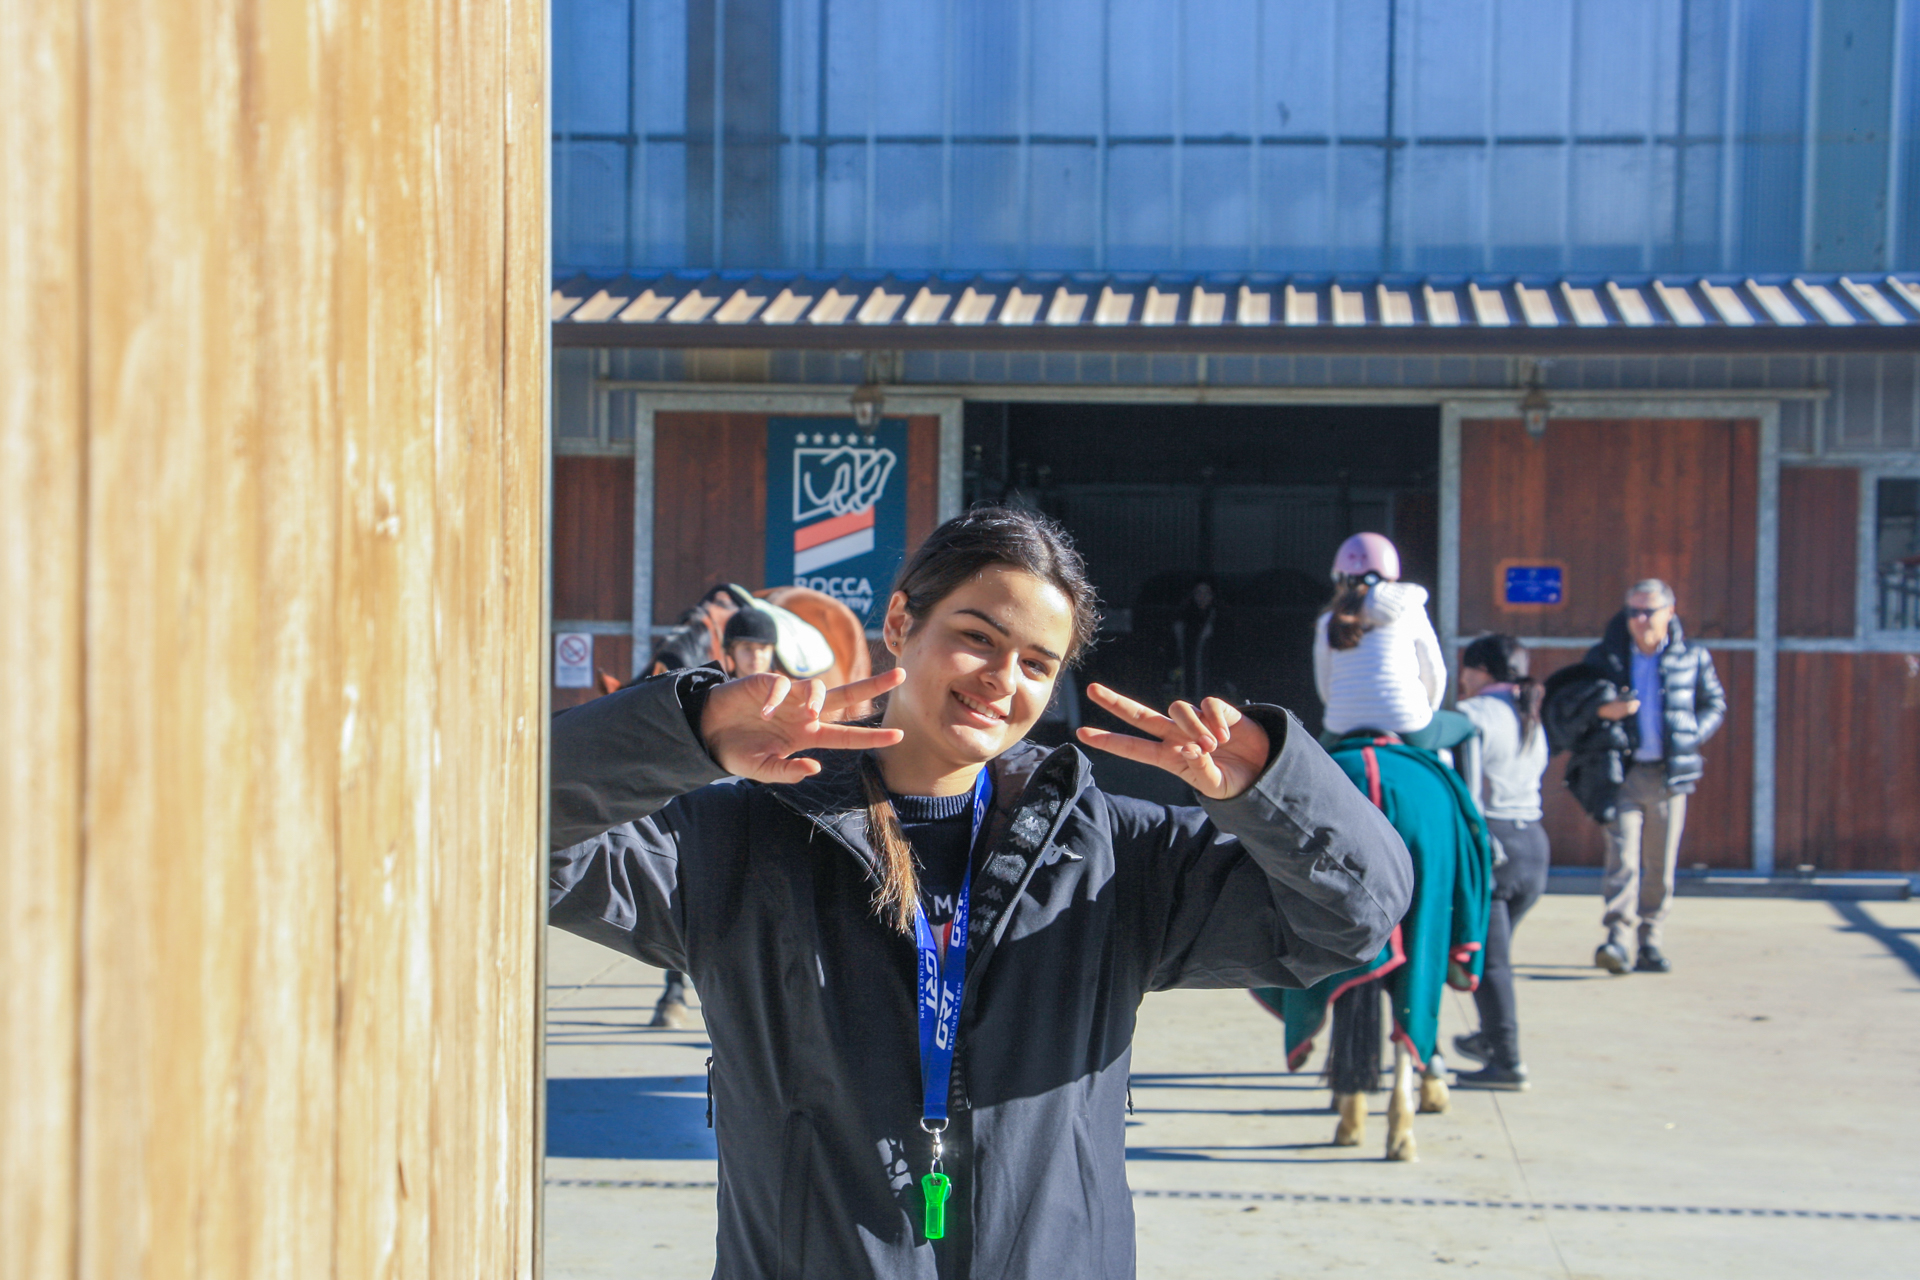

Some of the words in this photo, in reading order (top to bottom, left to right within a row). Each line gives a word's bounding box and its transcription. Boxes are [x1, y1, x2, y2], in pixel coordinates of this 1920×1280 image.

[925, 948, 938, 1018] GRT
[935, 980, 955, 1050] GRT
[947, 1015, 957, 1051] RACING
[954, 982, 962, 1007] TEAM
